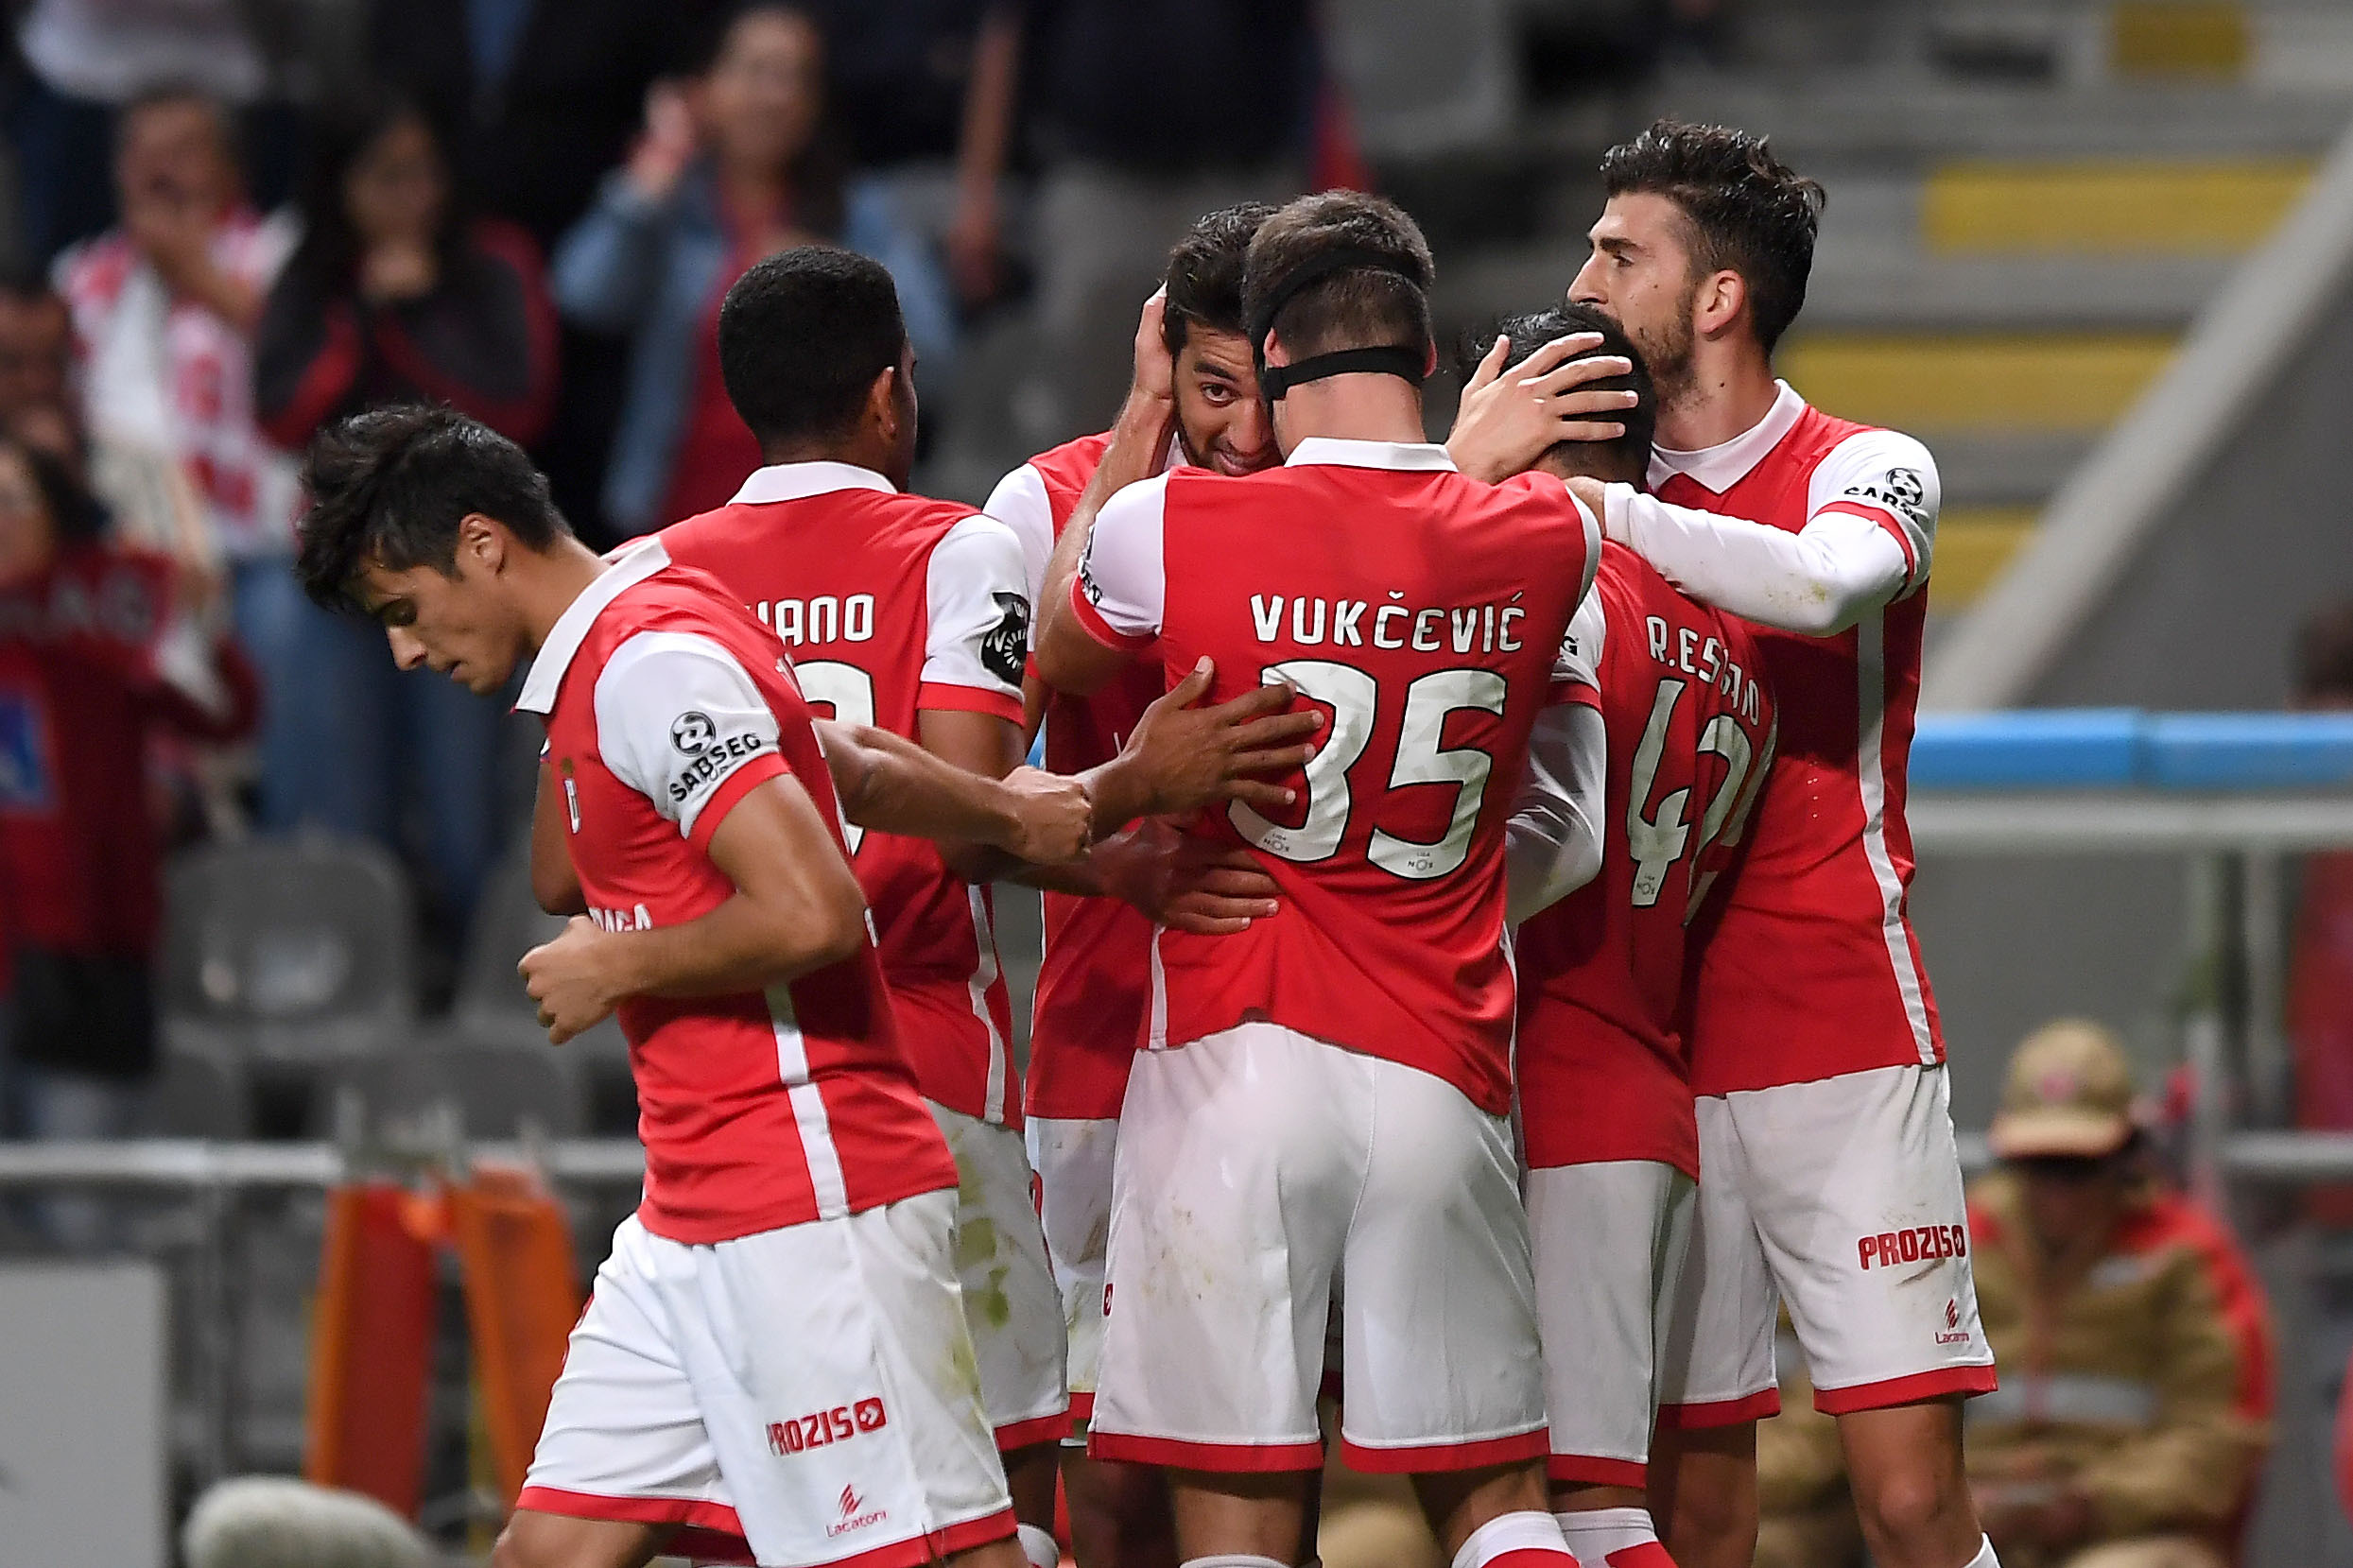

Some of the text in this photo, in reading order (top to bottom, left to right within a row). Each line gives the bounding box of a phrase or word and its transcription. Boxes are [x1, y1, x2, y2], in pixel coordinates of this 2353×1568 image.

[1249, 590, 1526, 654] VUKČEVIĆ
[668, 732, 762, 803] SABSEG
[1227, 659, 1509, 881] 35
[825, 1509, 888, 1538] Lacatoni
